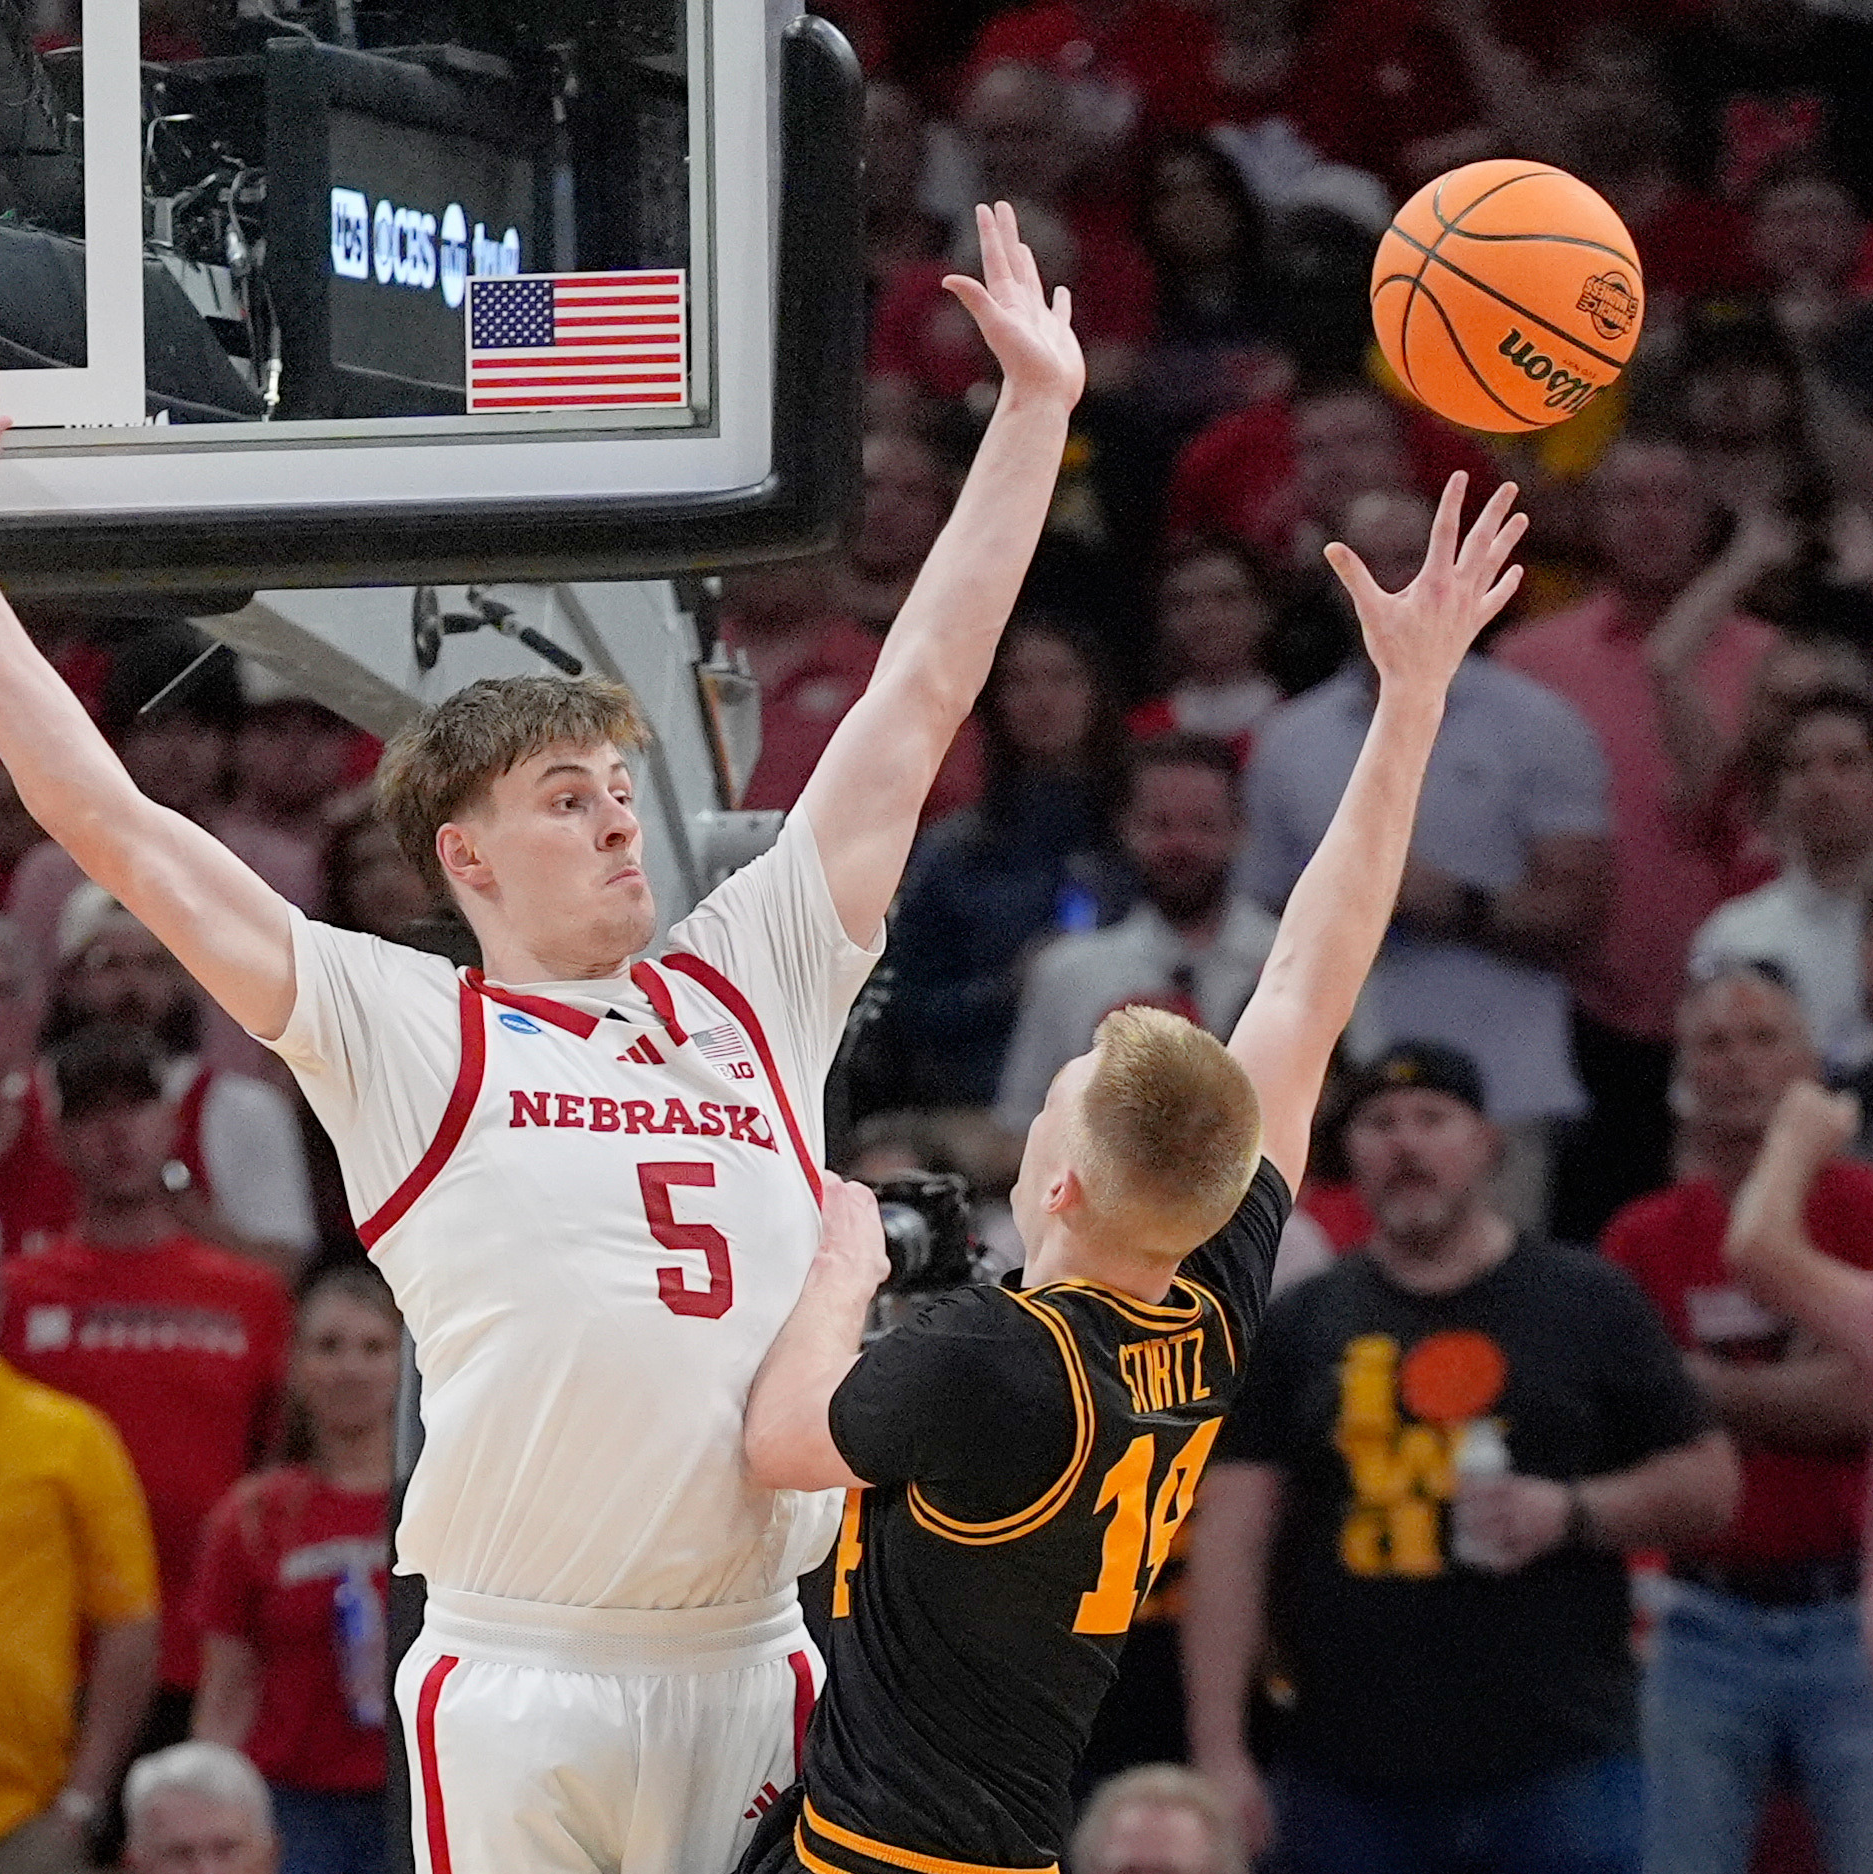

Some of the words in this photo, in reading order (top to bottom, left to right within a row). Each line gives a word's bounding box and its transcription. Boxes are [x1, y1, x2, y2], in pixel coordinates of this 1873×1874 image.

[394, 207, 437, 289] CBS
[637, 1161, 733, 1319] 5
[1119, 1327, 1211, 1414] STIRTZ
[1072, 1415, 1223, 1635] 14
